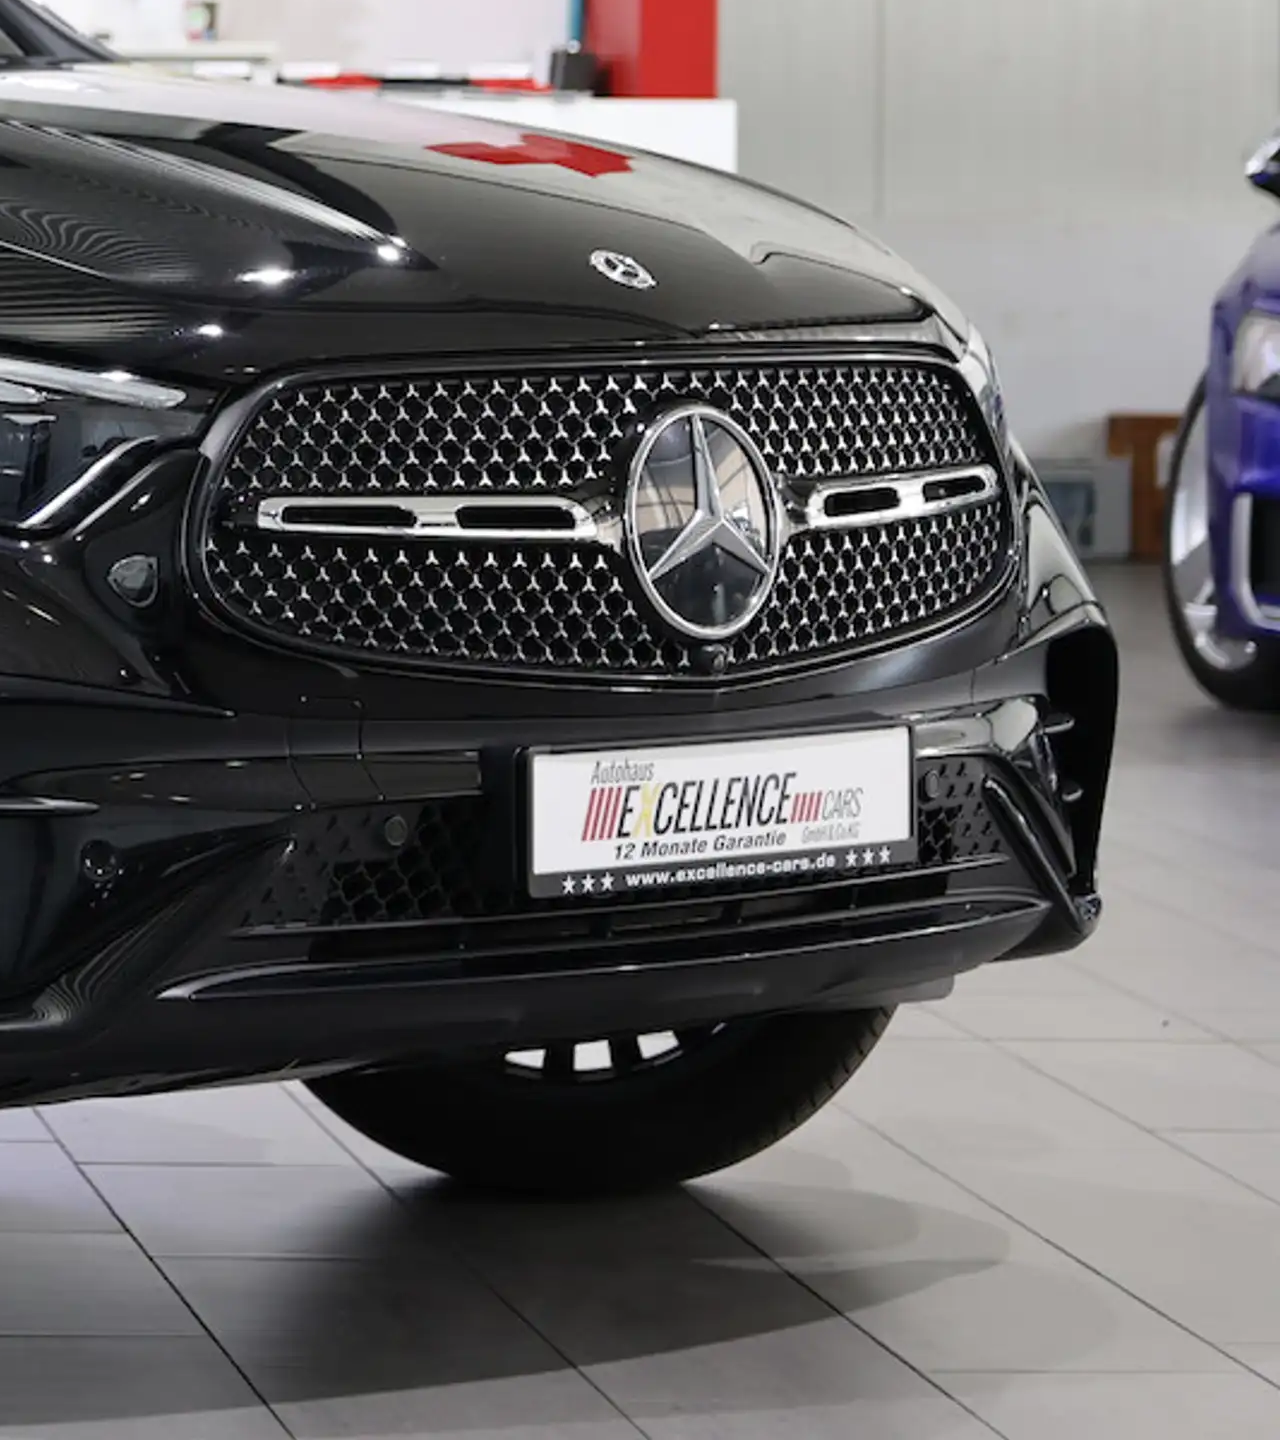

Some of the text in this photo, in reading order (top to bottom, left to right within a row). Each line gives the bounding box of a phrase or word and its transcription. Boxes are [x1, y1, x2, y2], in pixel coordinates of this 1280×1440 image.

[591, 757, 655, 784] Autohaus
[616, 771, 864, 839] EXCELLENCE CARS
[614, 830, 786, 860] 12 Monate Garantie
[625, 853, 836, 887] www.excellence-cars.de
